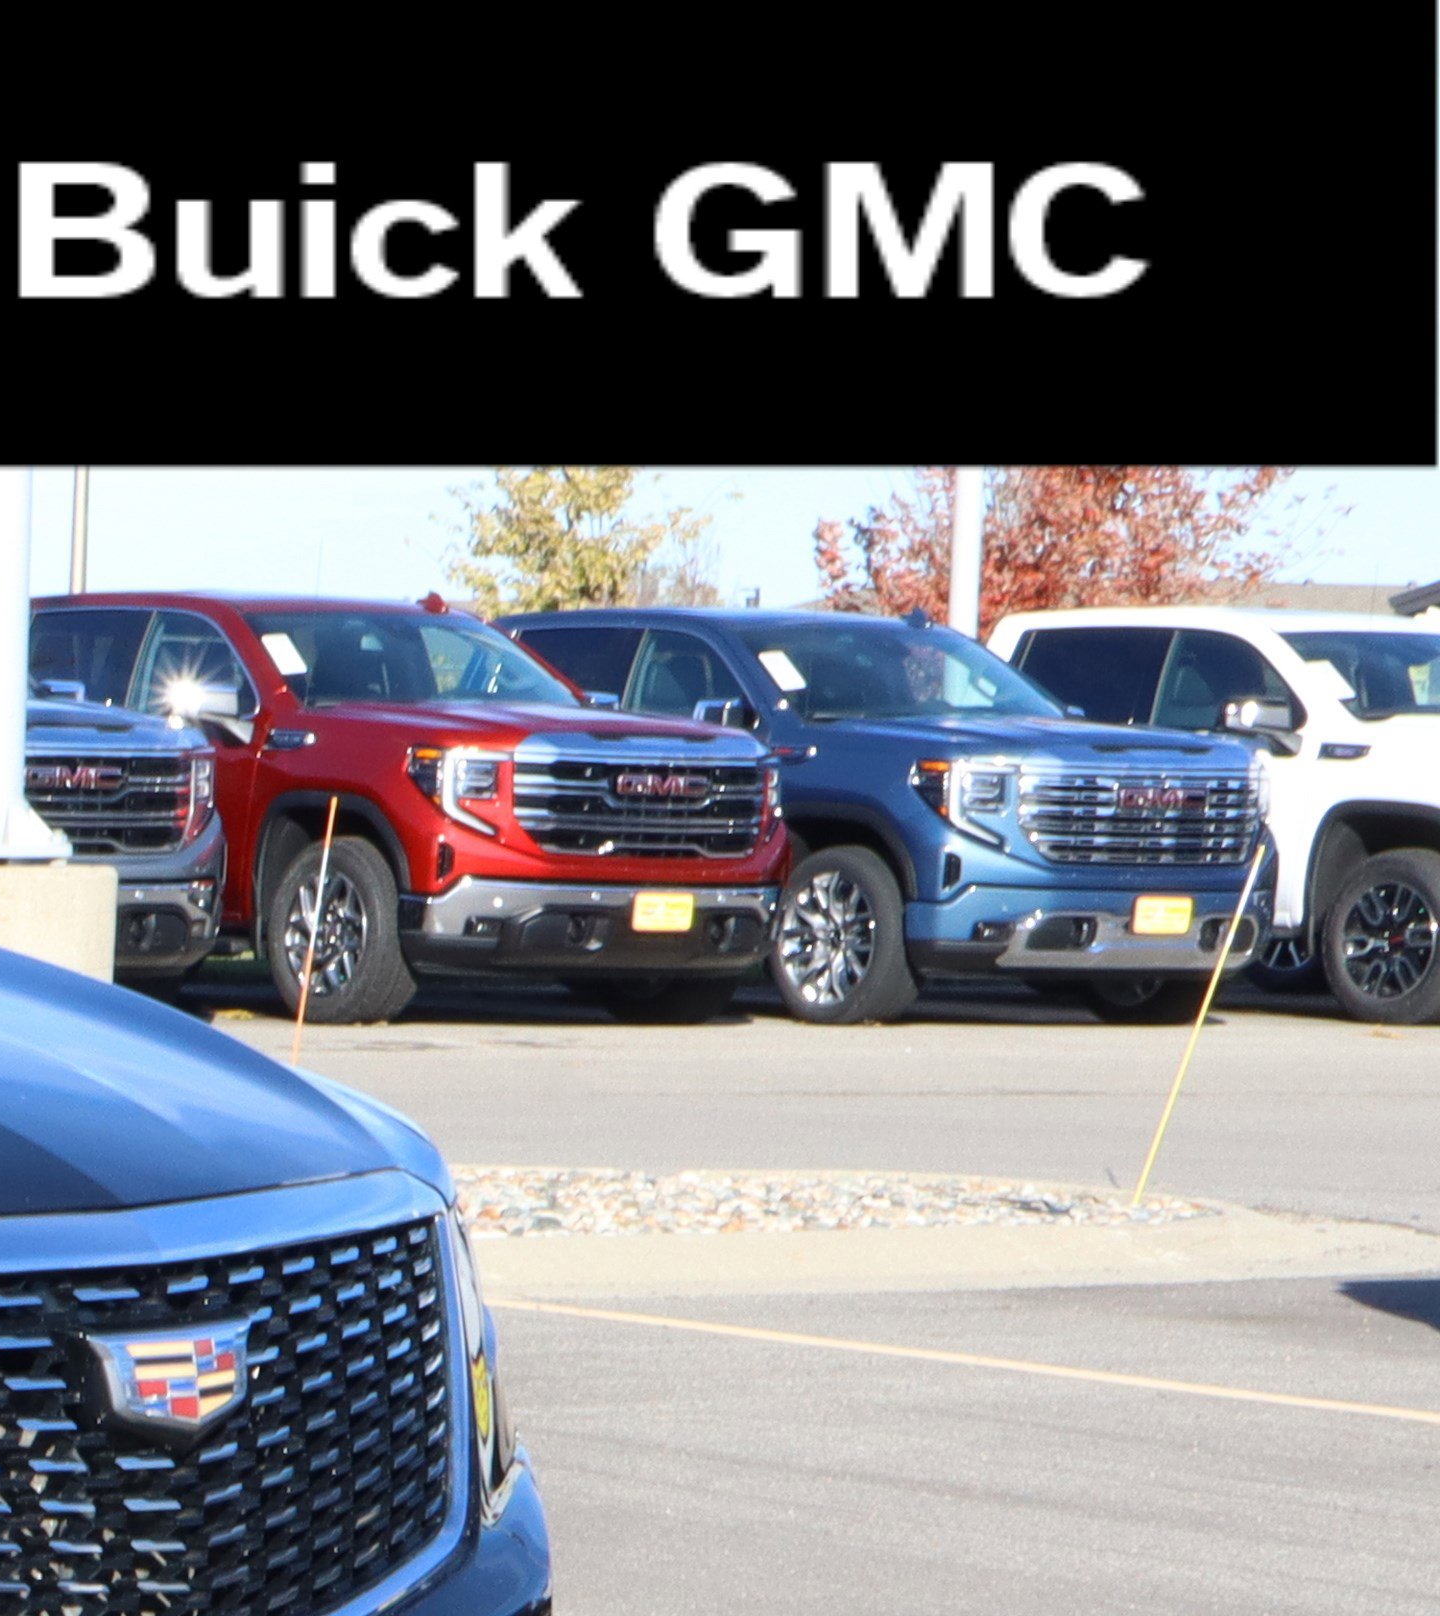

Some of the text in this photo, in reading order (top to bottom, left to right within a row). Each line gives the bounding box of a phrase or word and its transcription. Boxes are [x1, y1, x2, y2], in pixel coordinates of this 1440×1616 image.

[24, 765, 122, 789] GMC
[616, 773, 709, 797] GMC
[1119, 788, 1206, 810] GMC
